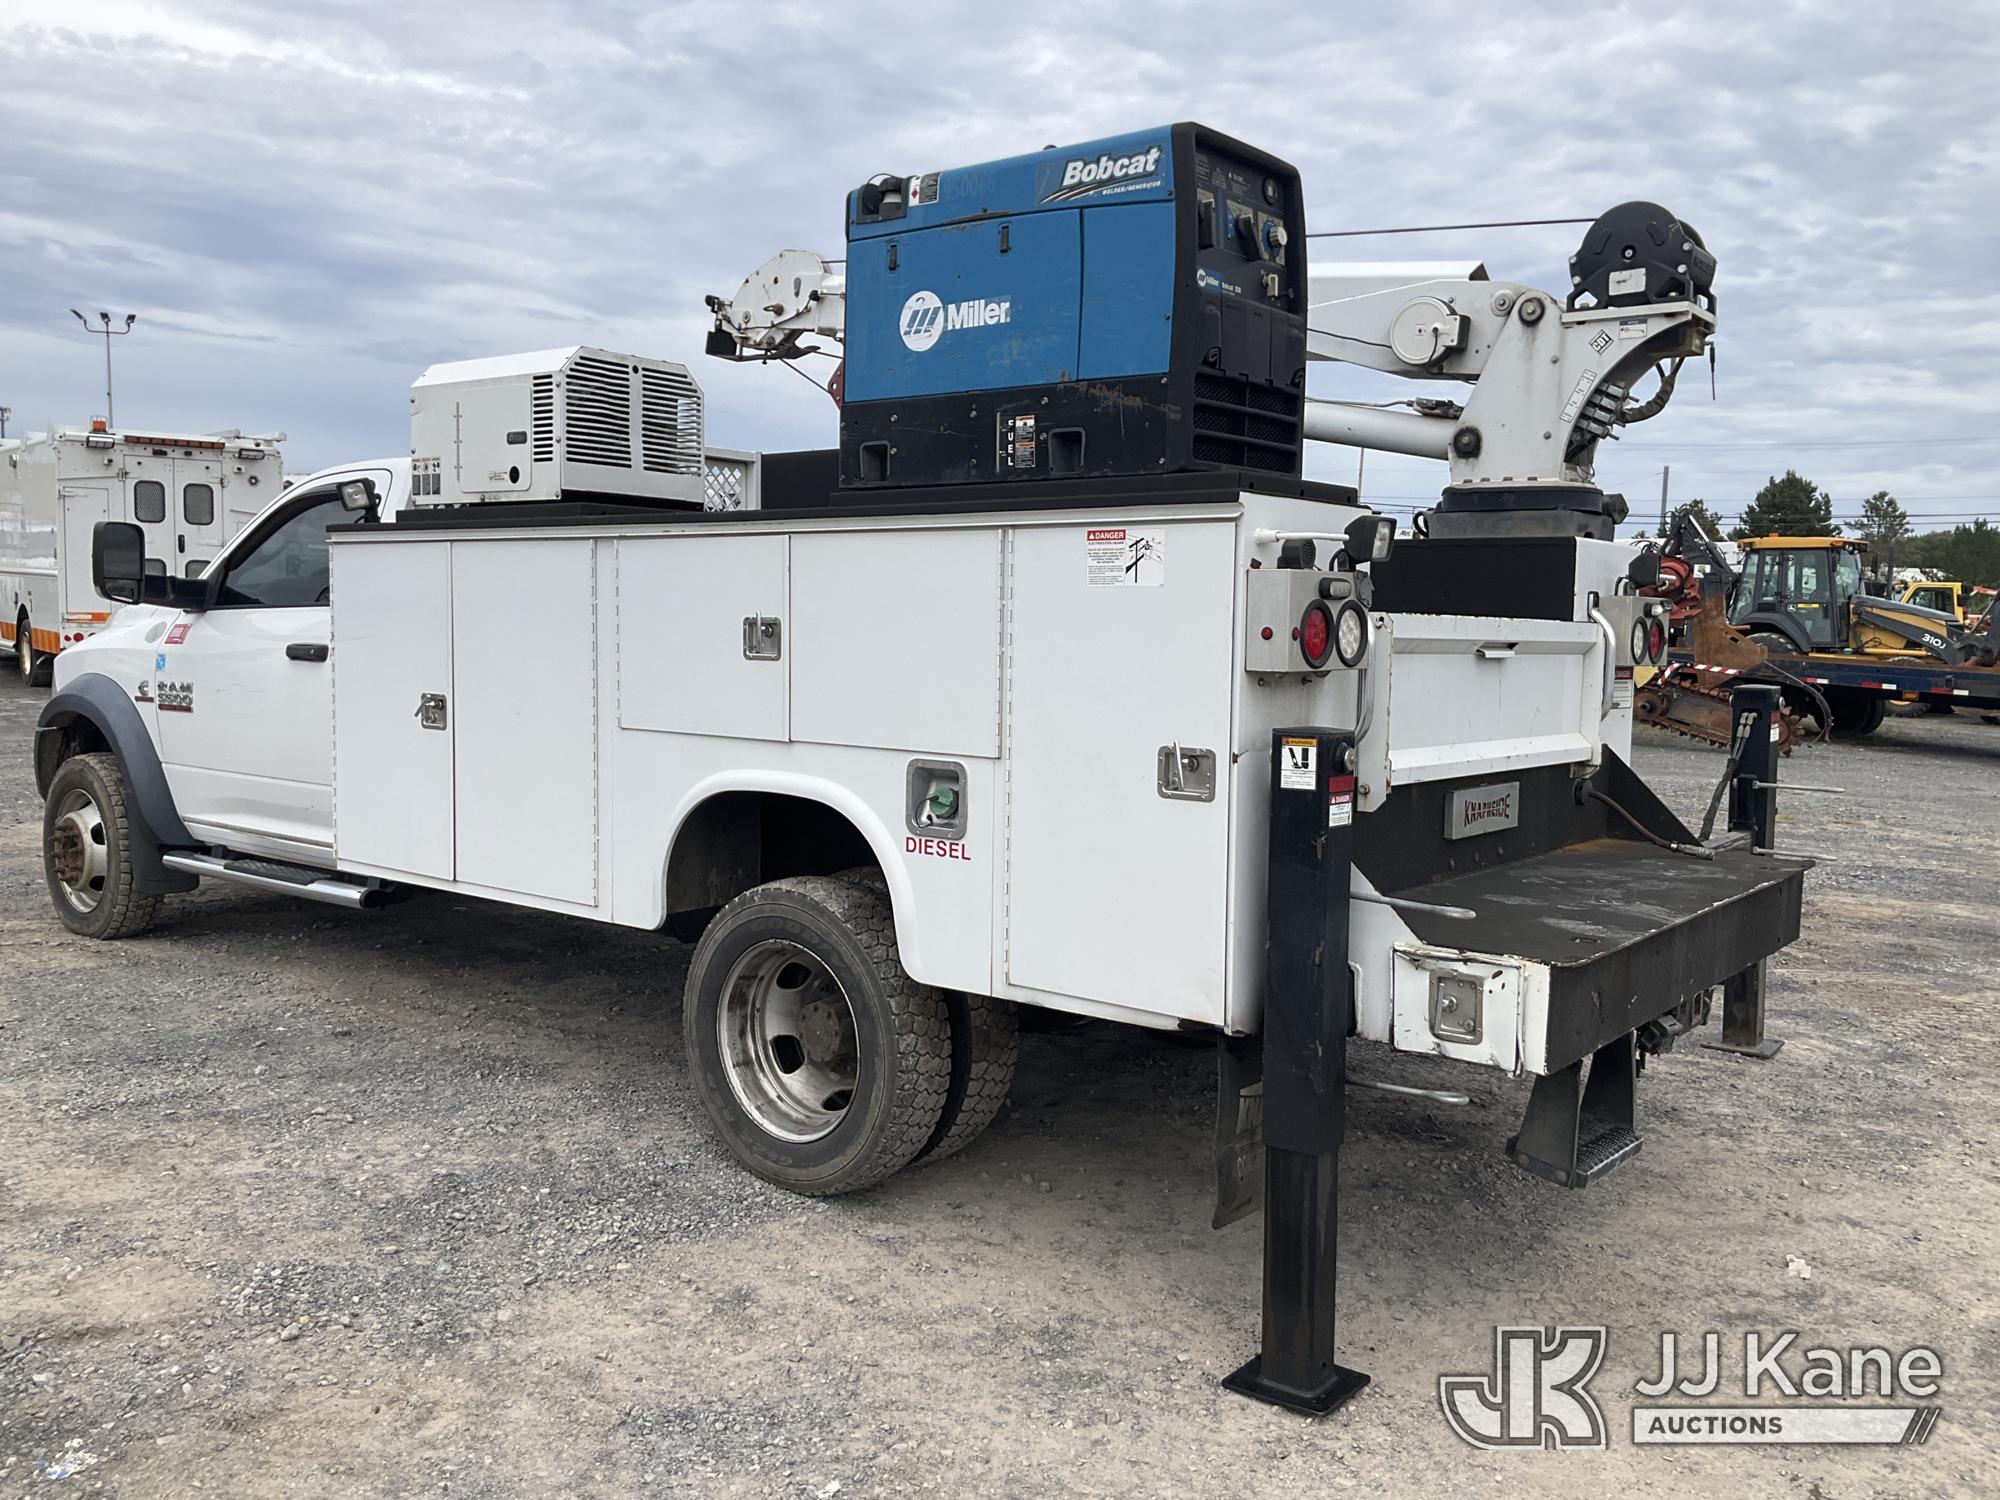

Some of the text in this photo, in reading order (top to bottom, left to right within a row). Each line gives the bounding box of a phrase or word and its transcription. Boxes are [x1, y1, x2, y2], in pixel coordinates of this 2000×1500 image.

[1062, 145, 1161, 187] Bobcat
[947, 299, 1011, 330] Miller
[1591, 333, 1611, 352] CDT
[1095, 531, 1124, 540] DANGER
[1922, 633, 1947, 649] 310J
[157, 680, 194, 694] RAM
[157, 692, 194, 707] 5500
[1335, 795, 1350, 803] DANGER
[1464, 792, 1511, 828] KNAPHEIDE
[905, 836, 971, 861] DIESEL
